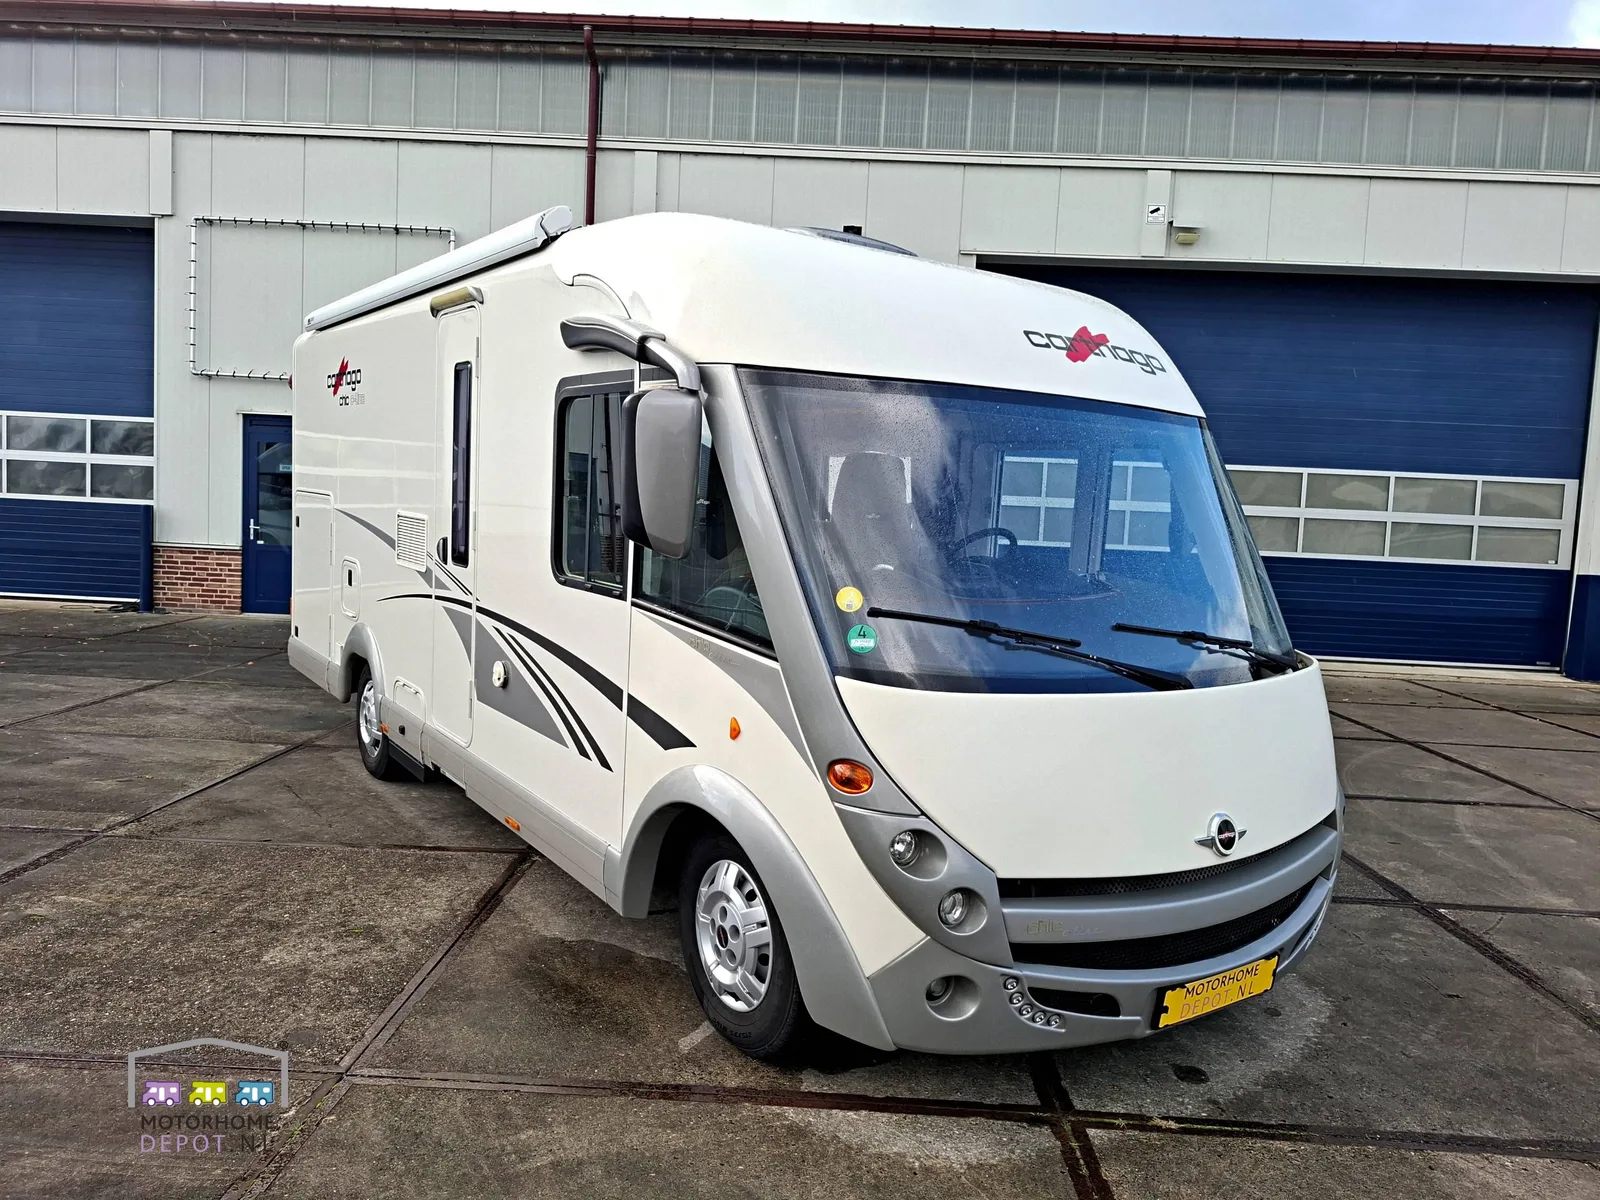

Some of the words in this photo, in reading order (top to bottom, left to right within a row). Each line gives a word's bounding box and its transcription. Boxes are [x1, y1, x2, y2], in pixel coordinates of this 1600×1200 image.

[857, 625, 867, 639] 4
[1180, 981, 1255, 1019] DEPOT.NL
[1184, 963, 1260, 1000] MOTORHOME
